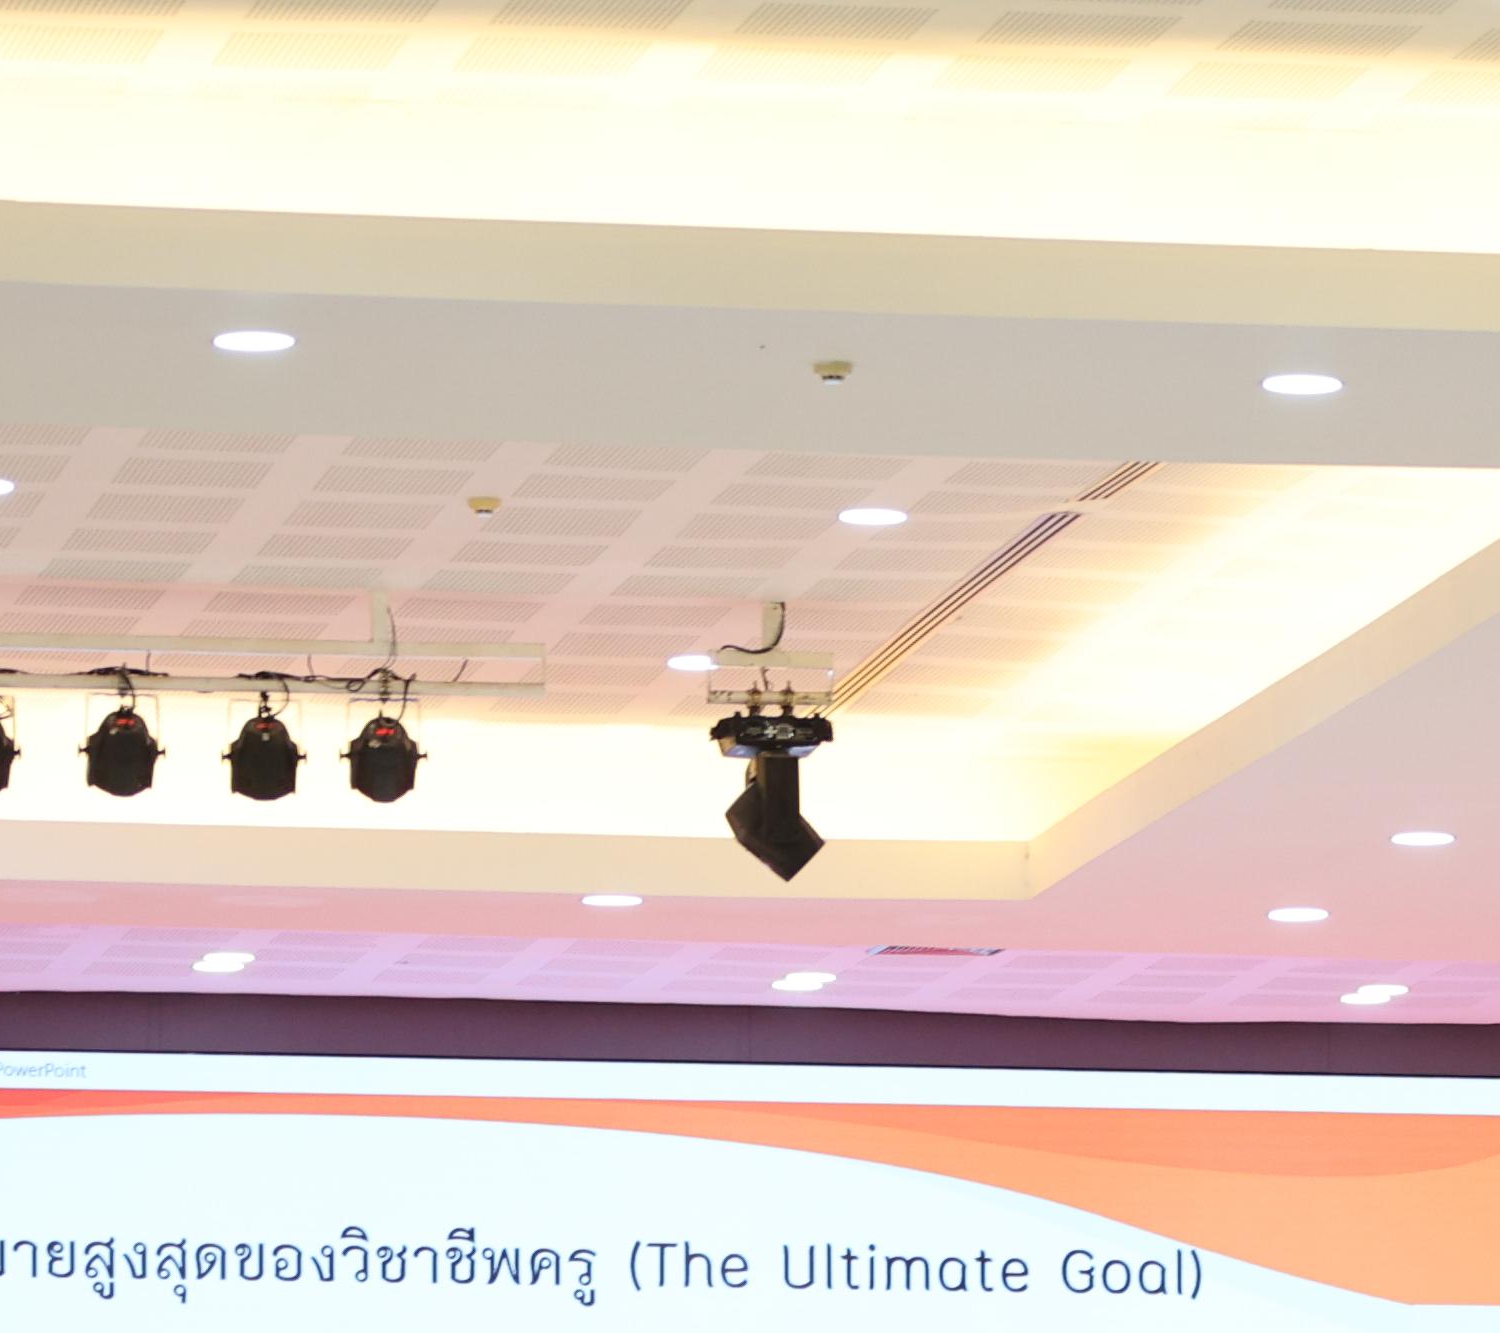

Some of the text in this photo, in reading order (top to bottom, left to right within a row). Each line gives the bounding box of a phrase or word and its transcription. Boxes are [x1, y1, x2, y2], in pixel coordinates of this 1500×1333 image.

[629, 1240, 750, 1292] (The
[783, 1243, 1030, 1293] Ultimate
[1060, 1247, 1205, 1300] Goal)
